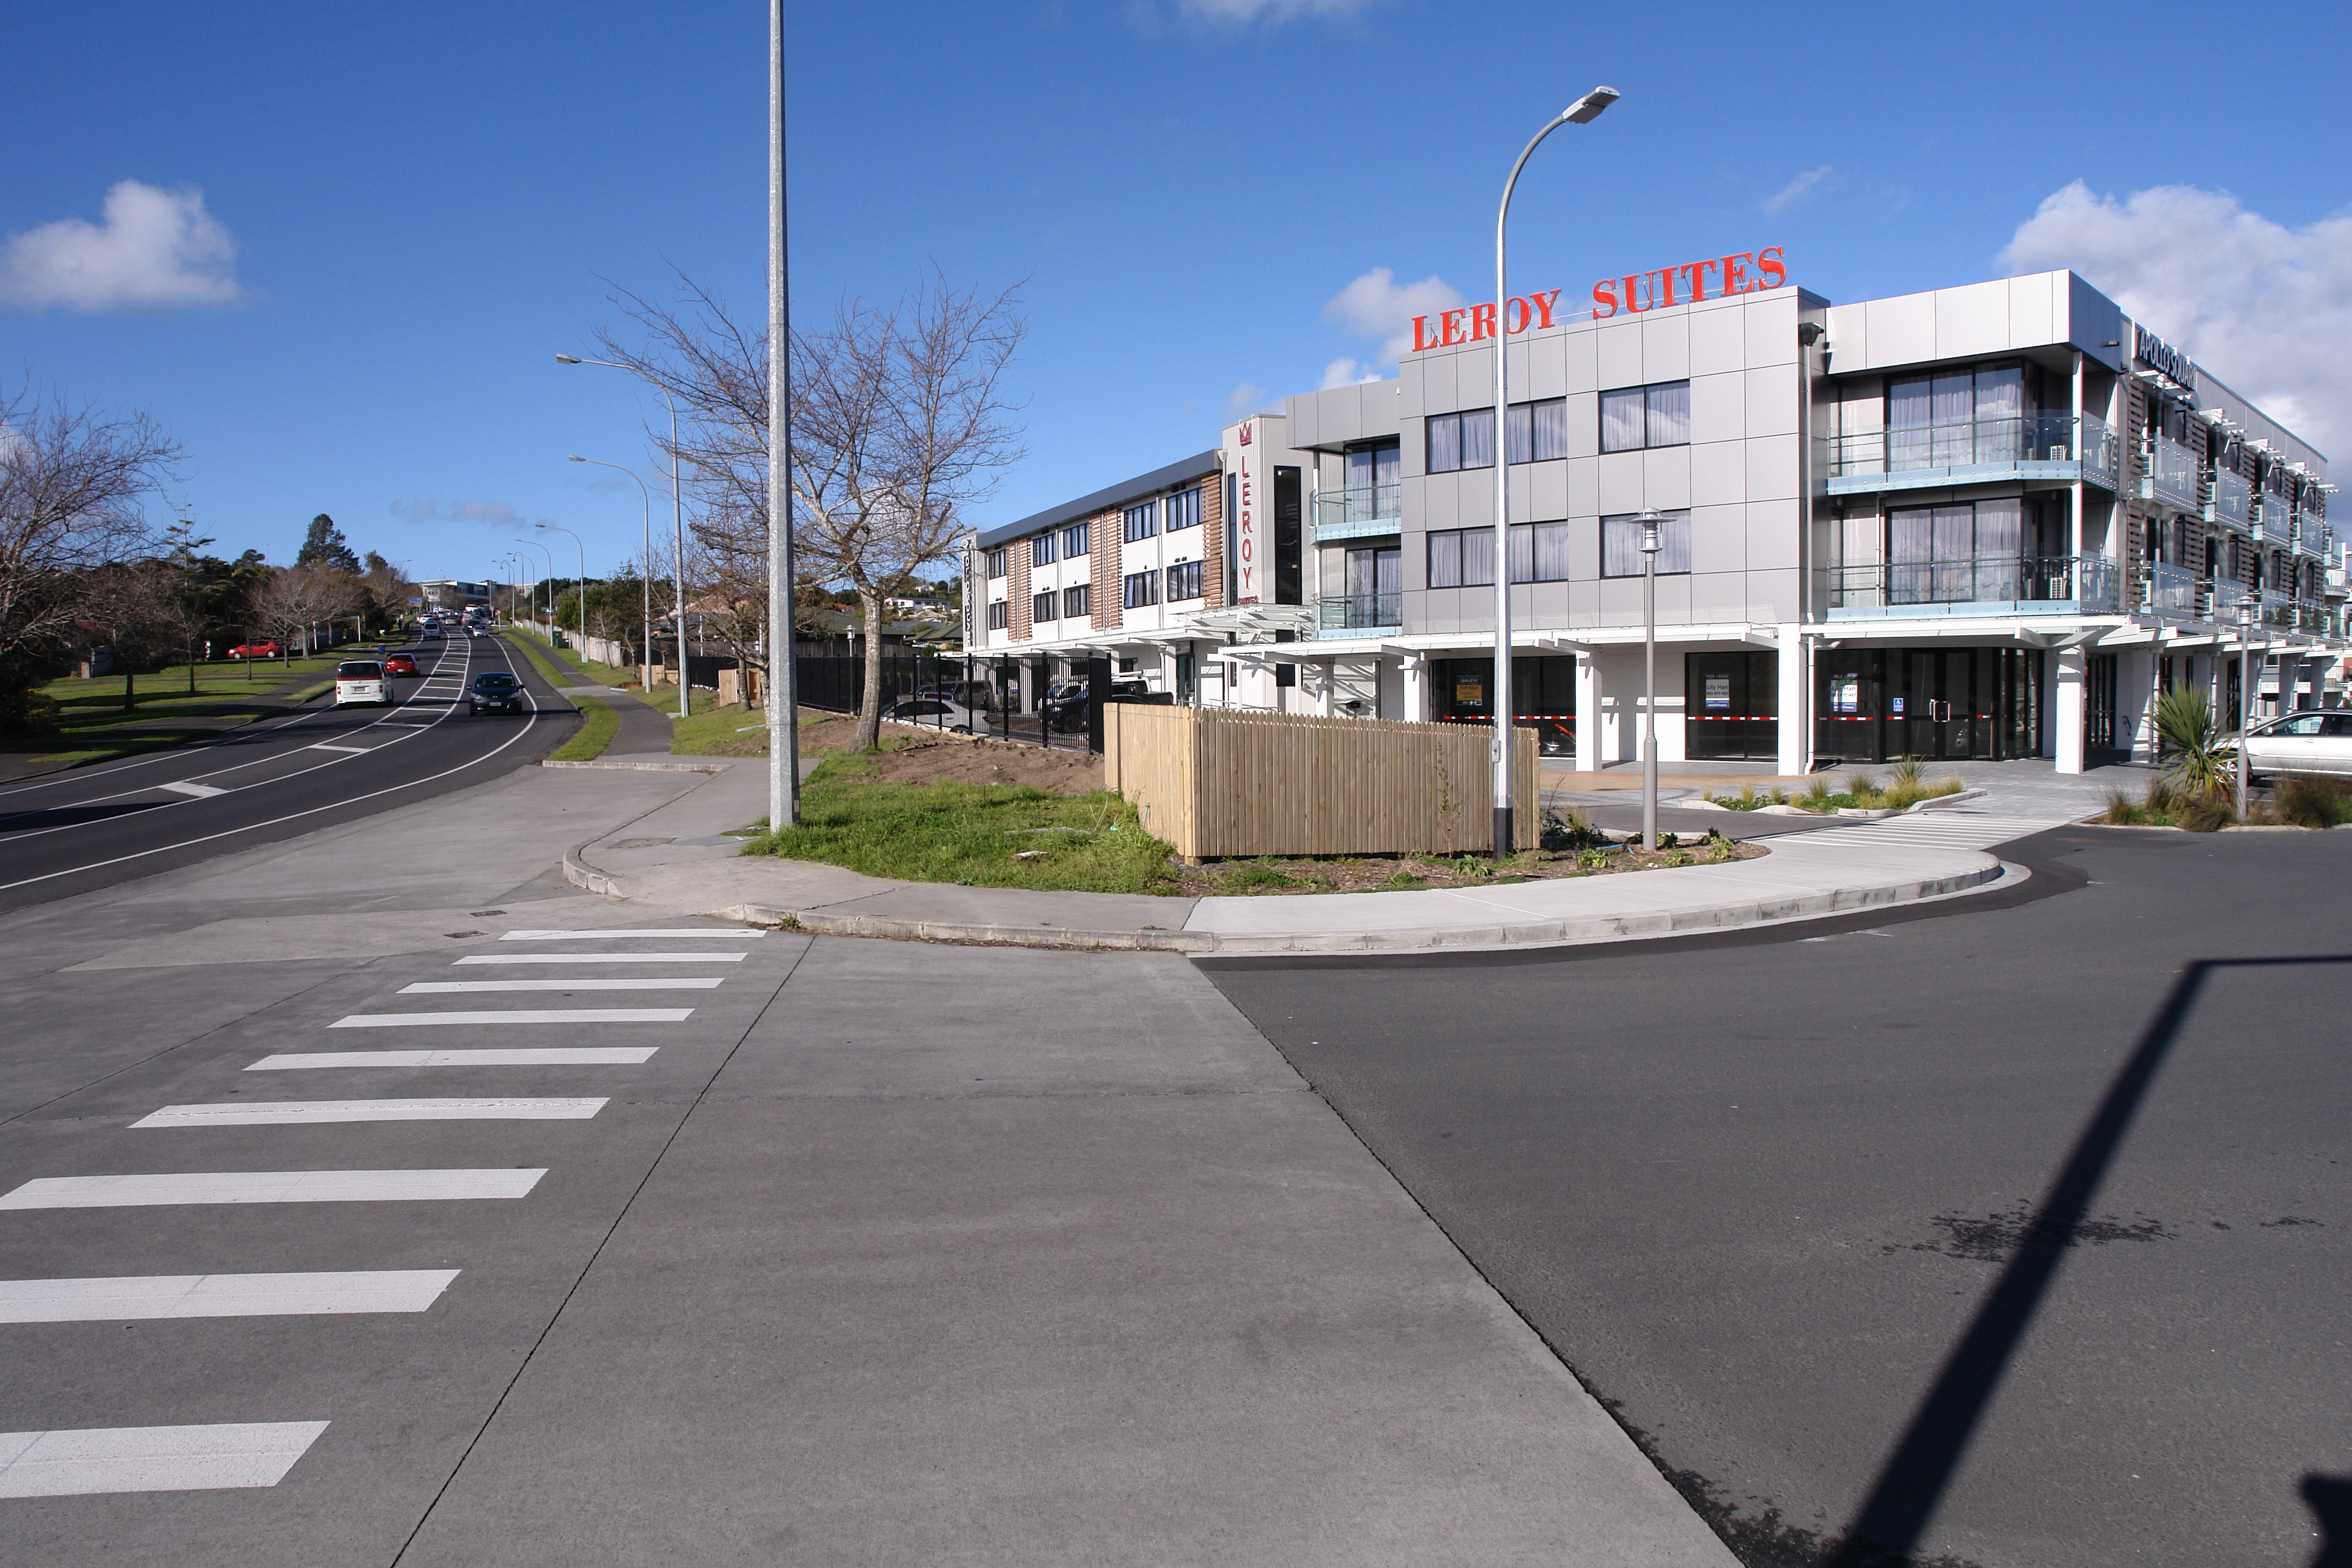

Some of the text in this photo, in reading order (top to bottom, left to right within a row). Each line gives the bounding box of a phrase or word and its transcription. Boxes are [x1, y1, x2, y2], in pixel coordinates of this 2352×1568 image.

[1411, 246, 1787, 352] LEROY SUITES
[2139, 331, 2197, 391] APOLLO SQUARE
[1241, 456, 1253, 590] LEROY
